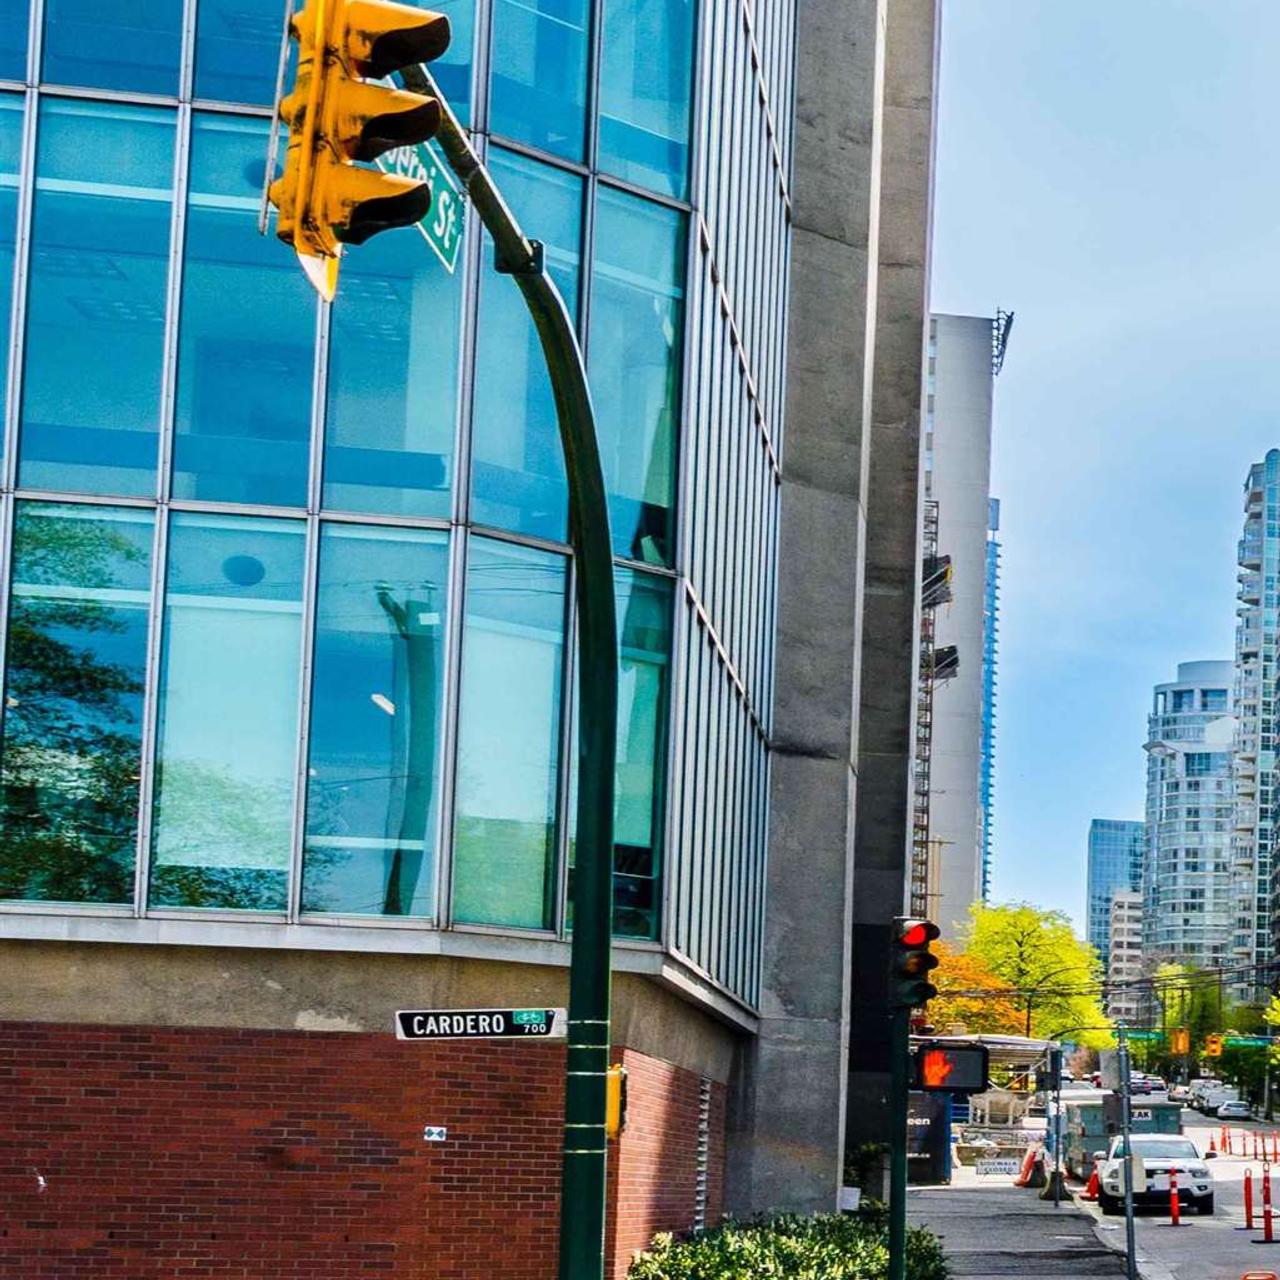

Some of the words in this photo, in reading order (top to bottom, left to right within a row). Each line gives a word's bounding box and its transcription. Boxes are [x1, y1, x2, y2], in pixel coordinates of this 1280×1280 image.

[433, 190, 456, 249] St
[413, 1014, 504, 1035] CARDERO
[523, 1023, 546, 1033] 700
